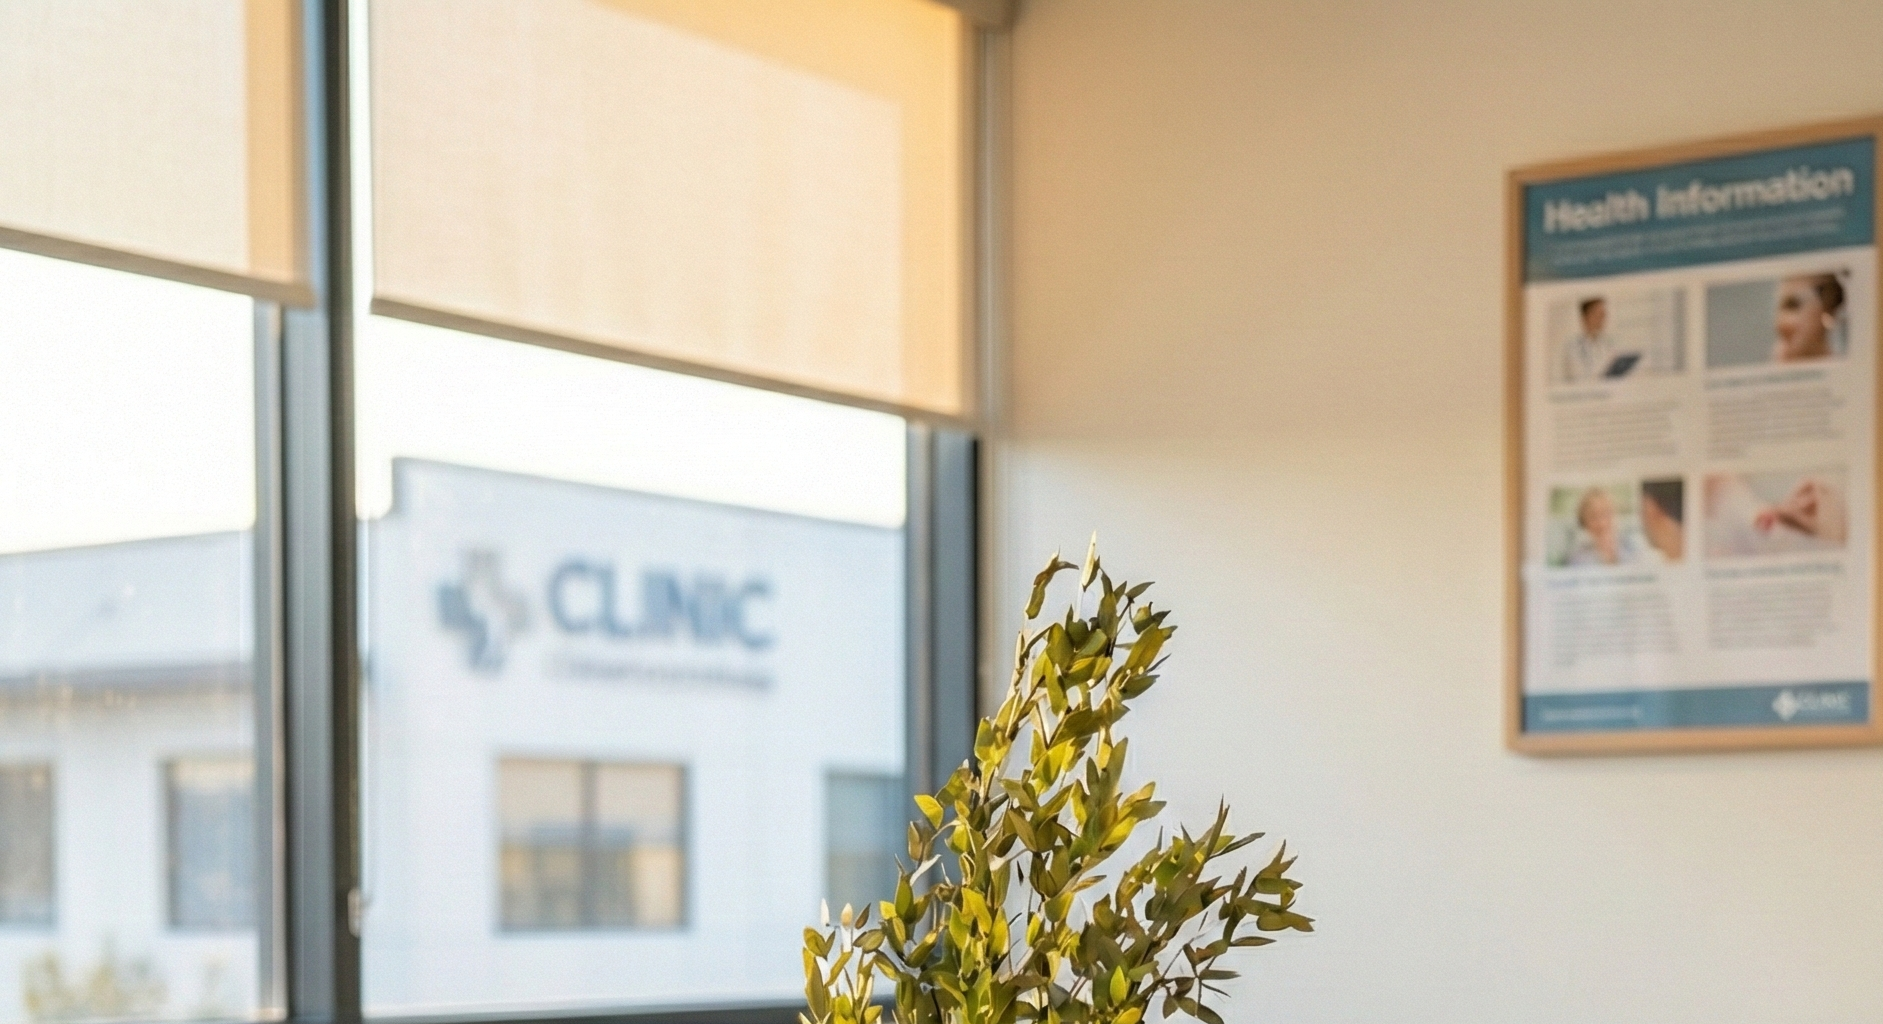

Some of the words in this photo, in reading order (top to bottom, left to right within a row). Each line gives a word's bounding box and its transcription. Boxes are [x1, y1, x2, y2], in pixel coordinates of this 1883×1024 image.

[1543, 189, 1649, 233] Health
[1656, 167, 1854, 218] Information
[547, 555, 774, 648] CLINIC
